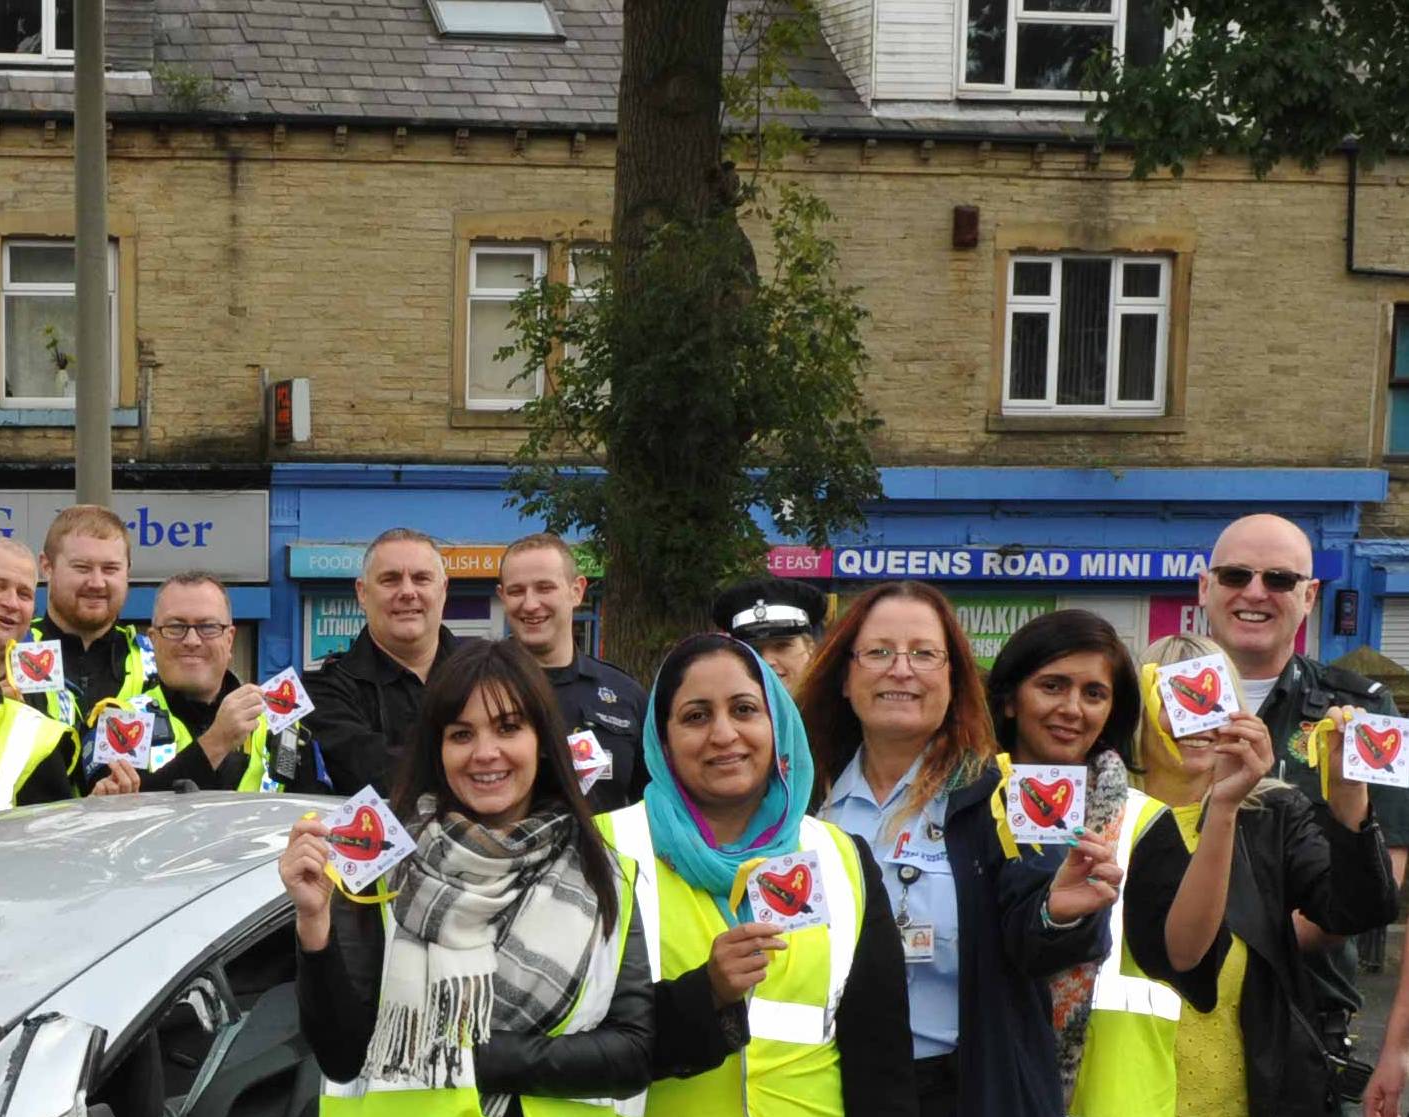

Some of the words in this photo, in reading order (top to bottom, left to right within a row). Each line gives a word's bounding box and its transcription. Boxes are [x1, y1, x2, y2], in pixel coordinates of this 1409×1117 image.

[309, 555, 353, 570] FOOD
[786, 555, 822, 570] EAST
[838, 549, 973, 576] QUEENS
[981, 551, 1070, 577] ROAD
[1079, 552, 1151, 577] MINI
[1161, 553, 1209, 577] MA
[320, 600, 366, 616] LATVIA
[316, 618, 365, 637] LITHUA
